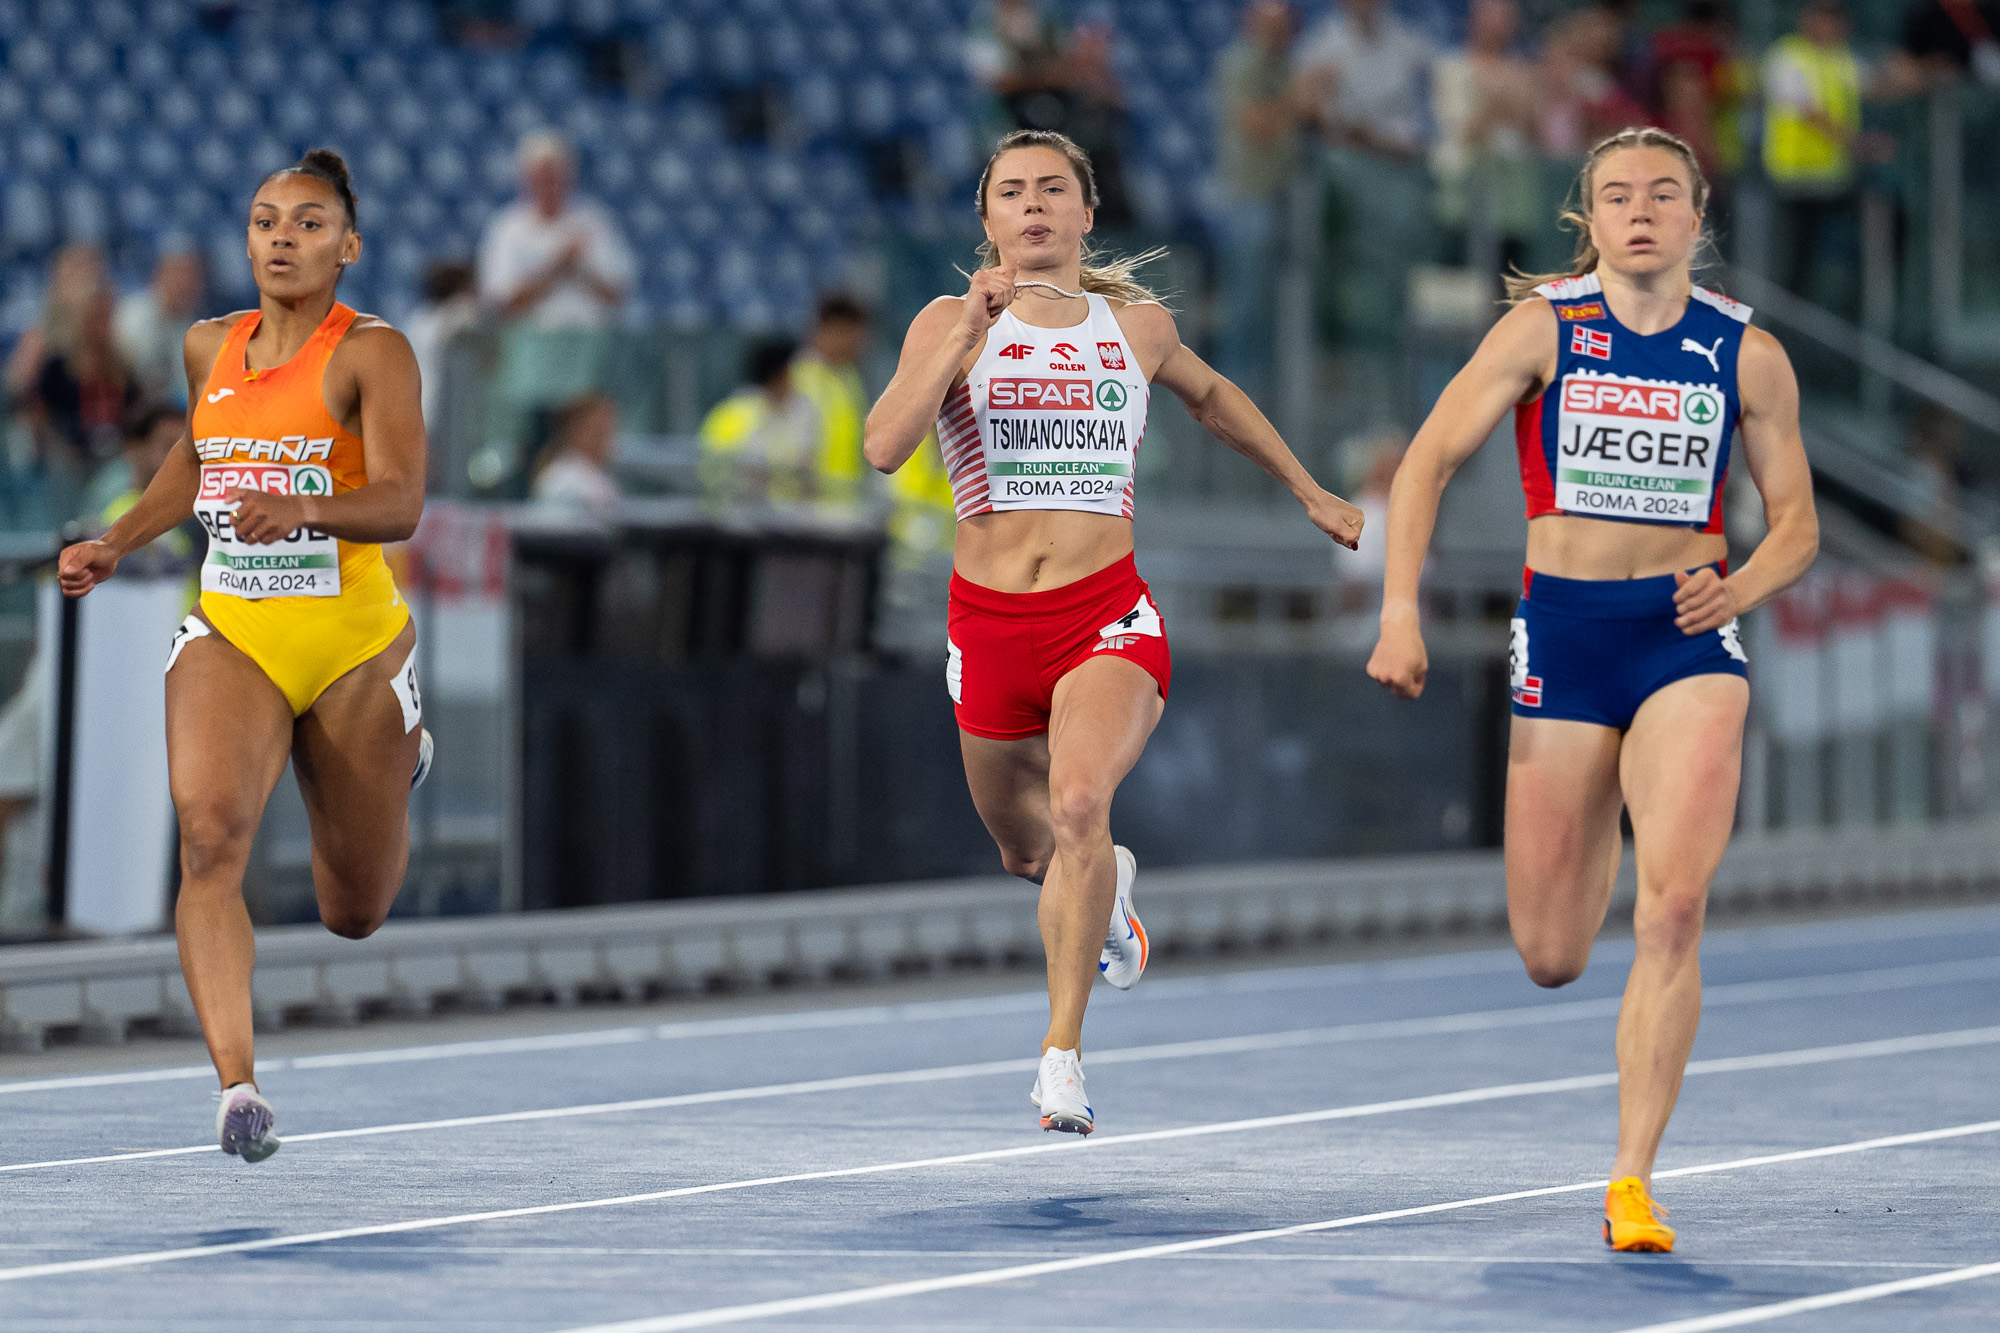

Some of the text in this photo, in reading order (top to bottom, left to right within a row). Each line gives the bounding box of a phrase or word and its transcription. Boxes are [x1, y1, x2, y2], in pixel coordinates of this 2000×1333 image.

[1049, 362, 1086, 372] ORLEN
[991, 382, 1091, 406] SPAR
[1566, 383, 1678, 417] SPAR
[990, 418, 1127, 451] TSIMANOUSKAYA
[1562, 424, 1710, 468] JÆGER
[194, 435, 336, 462] ESPAÑA
[1023, 463, 1053, 474] RUN
[1594, 473, 1628, 487] RUN
[202, 470, 289, 497] SPAR
[1006, 480, 1113, 496] ROMA 2024
[1575, 490, 1690, 515] ROMA 2024
[268, 574, 317, 591] 2024
